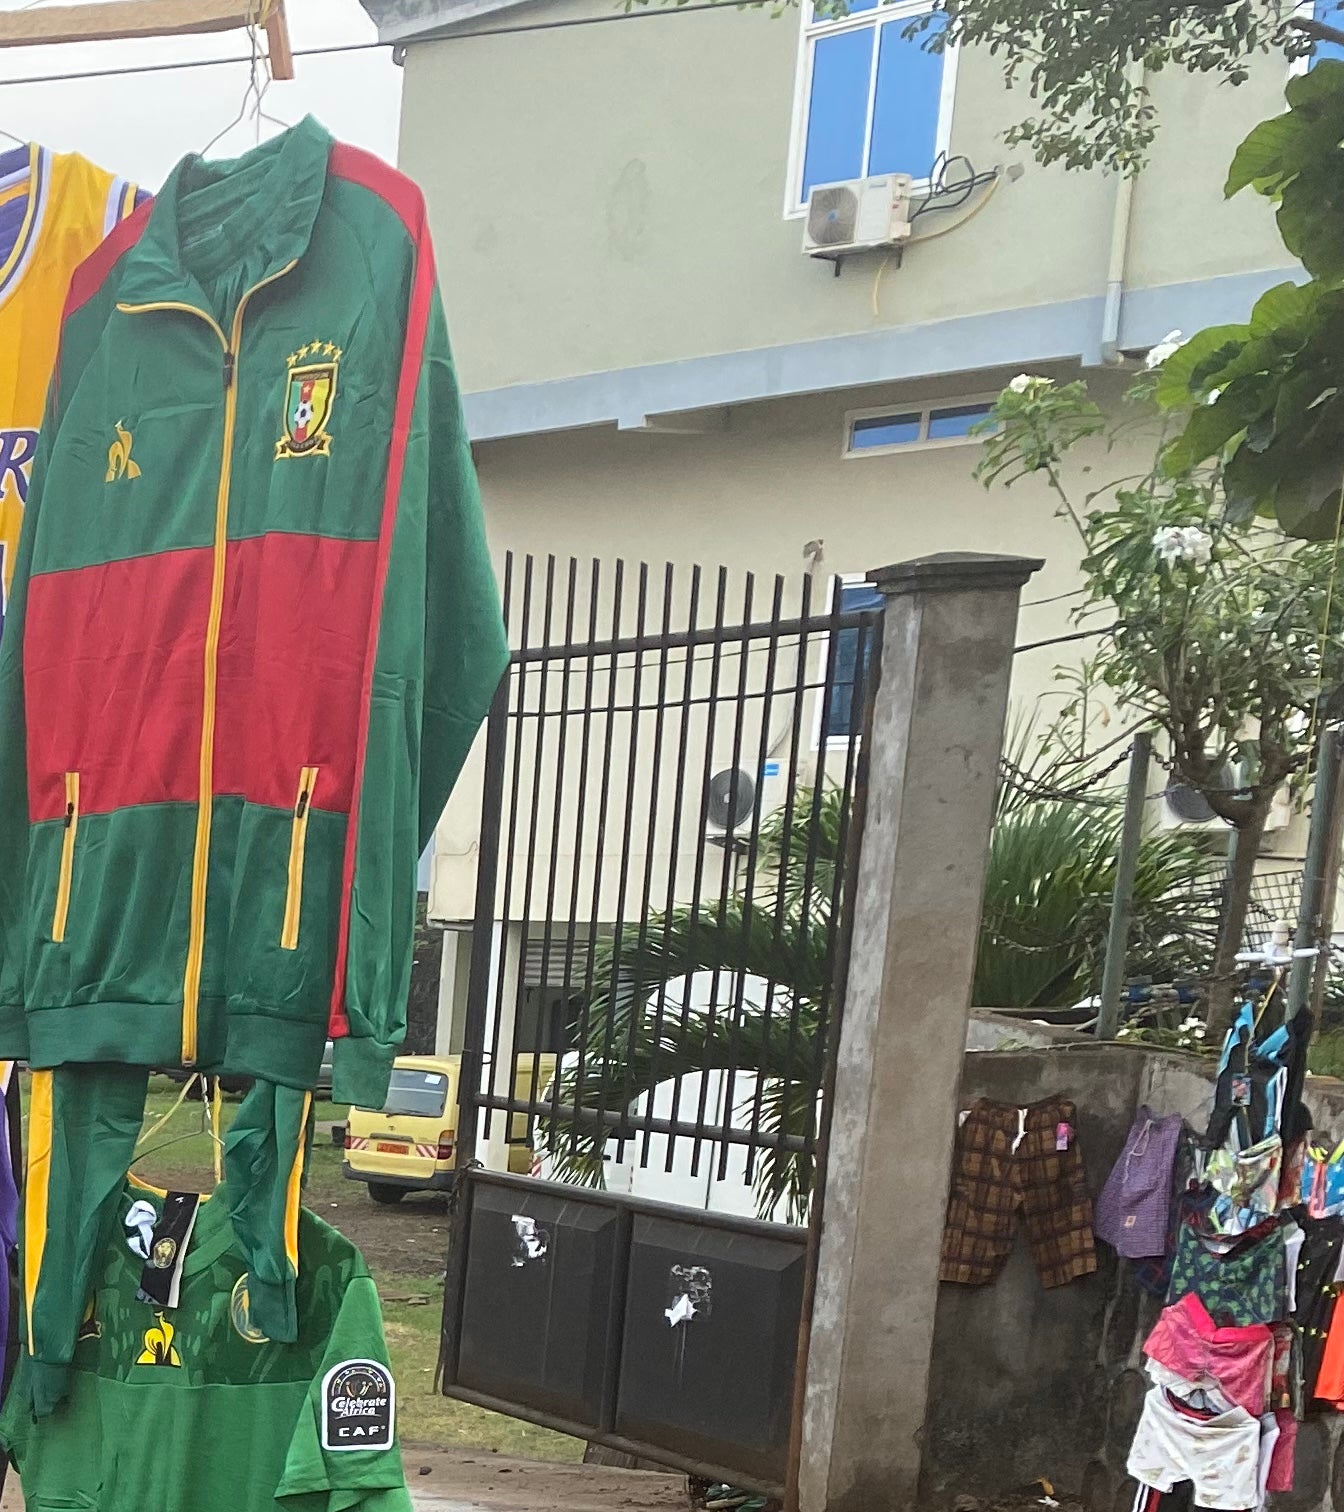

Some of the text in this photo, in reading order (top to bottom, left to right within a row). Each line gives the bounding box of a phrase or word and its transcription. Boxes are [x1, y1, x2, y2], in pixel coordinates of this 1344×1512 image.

[331, 1396, 387, 1413] Celebrate
[340, 1406, 376, 1418] Africa
[338, 1426, 380, 1437] CAF
